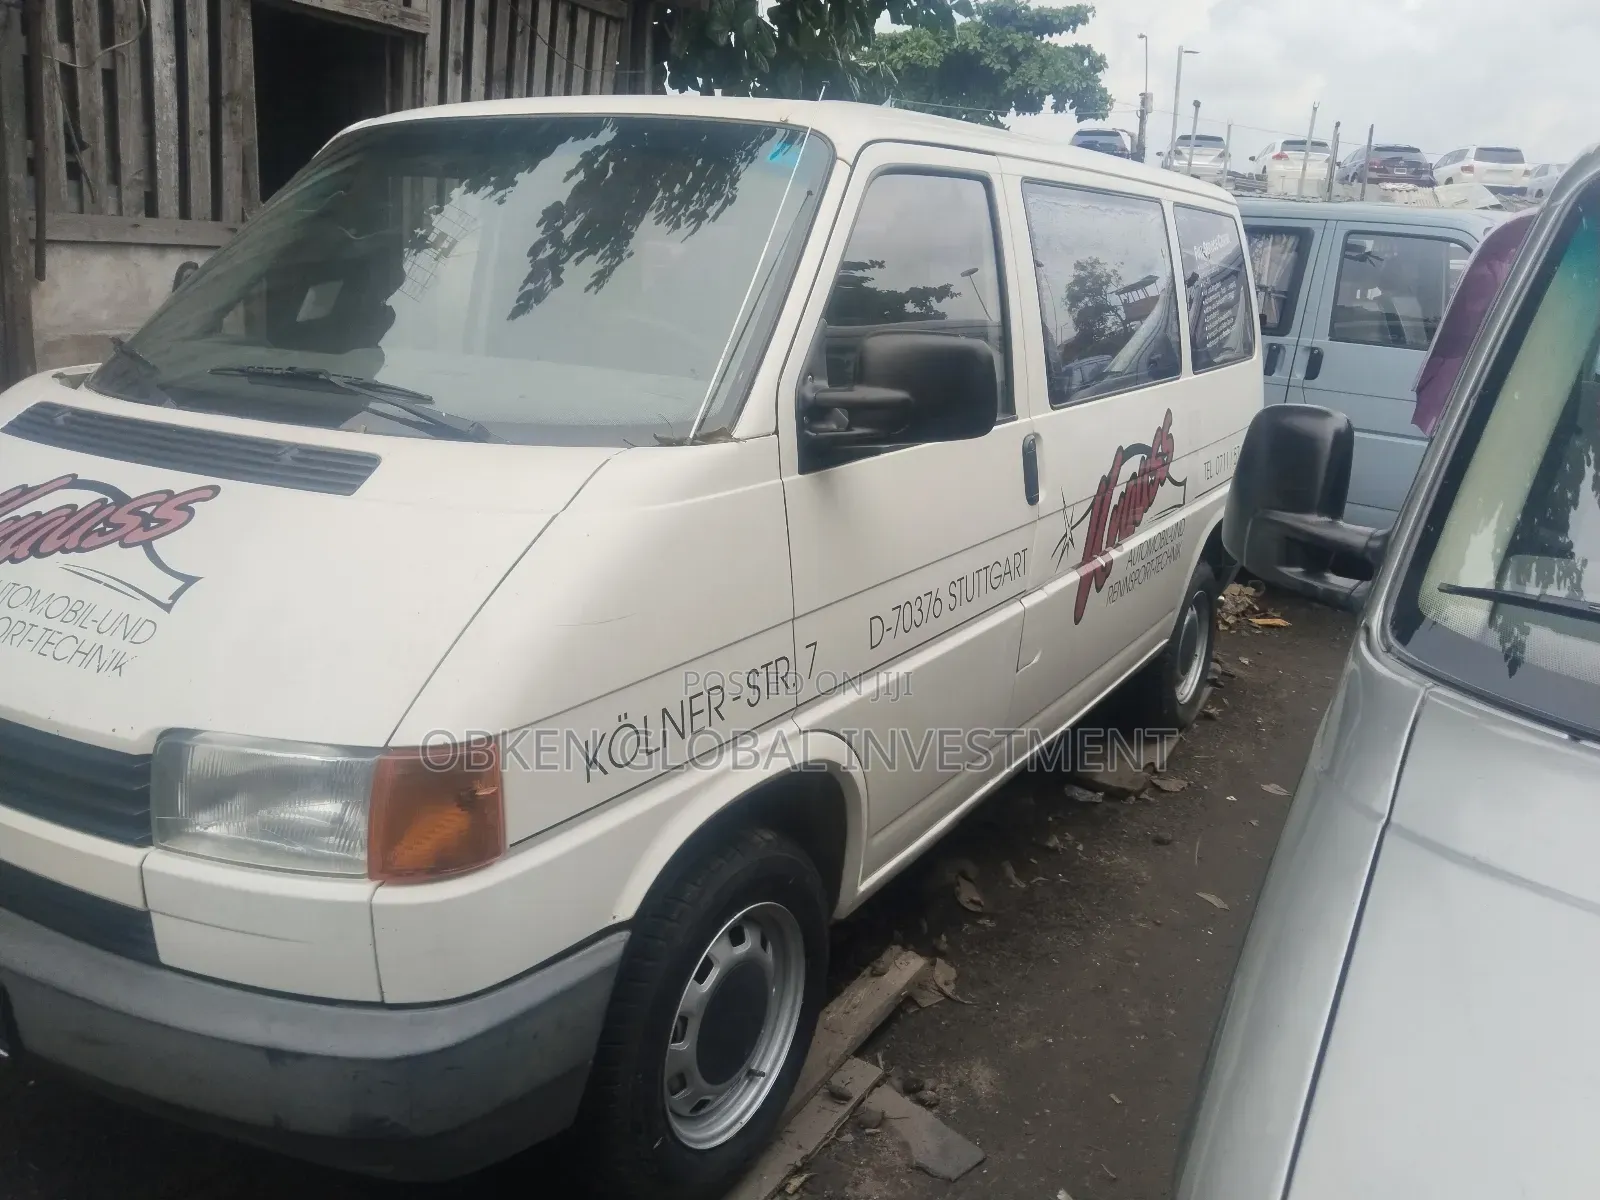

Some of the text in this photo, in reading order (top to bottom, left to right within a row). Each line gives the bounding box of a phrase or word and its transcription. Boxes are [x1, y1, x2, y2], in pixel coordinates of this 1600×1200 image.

[868, 547, 1028, 650] D-70376 STUTTGART
[804, 641, 819, 680] 7
